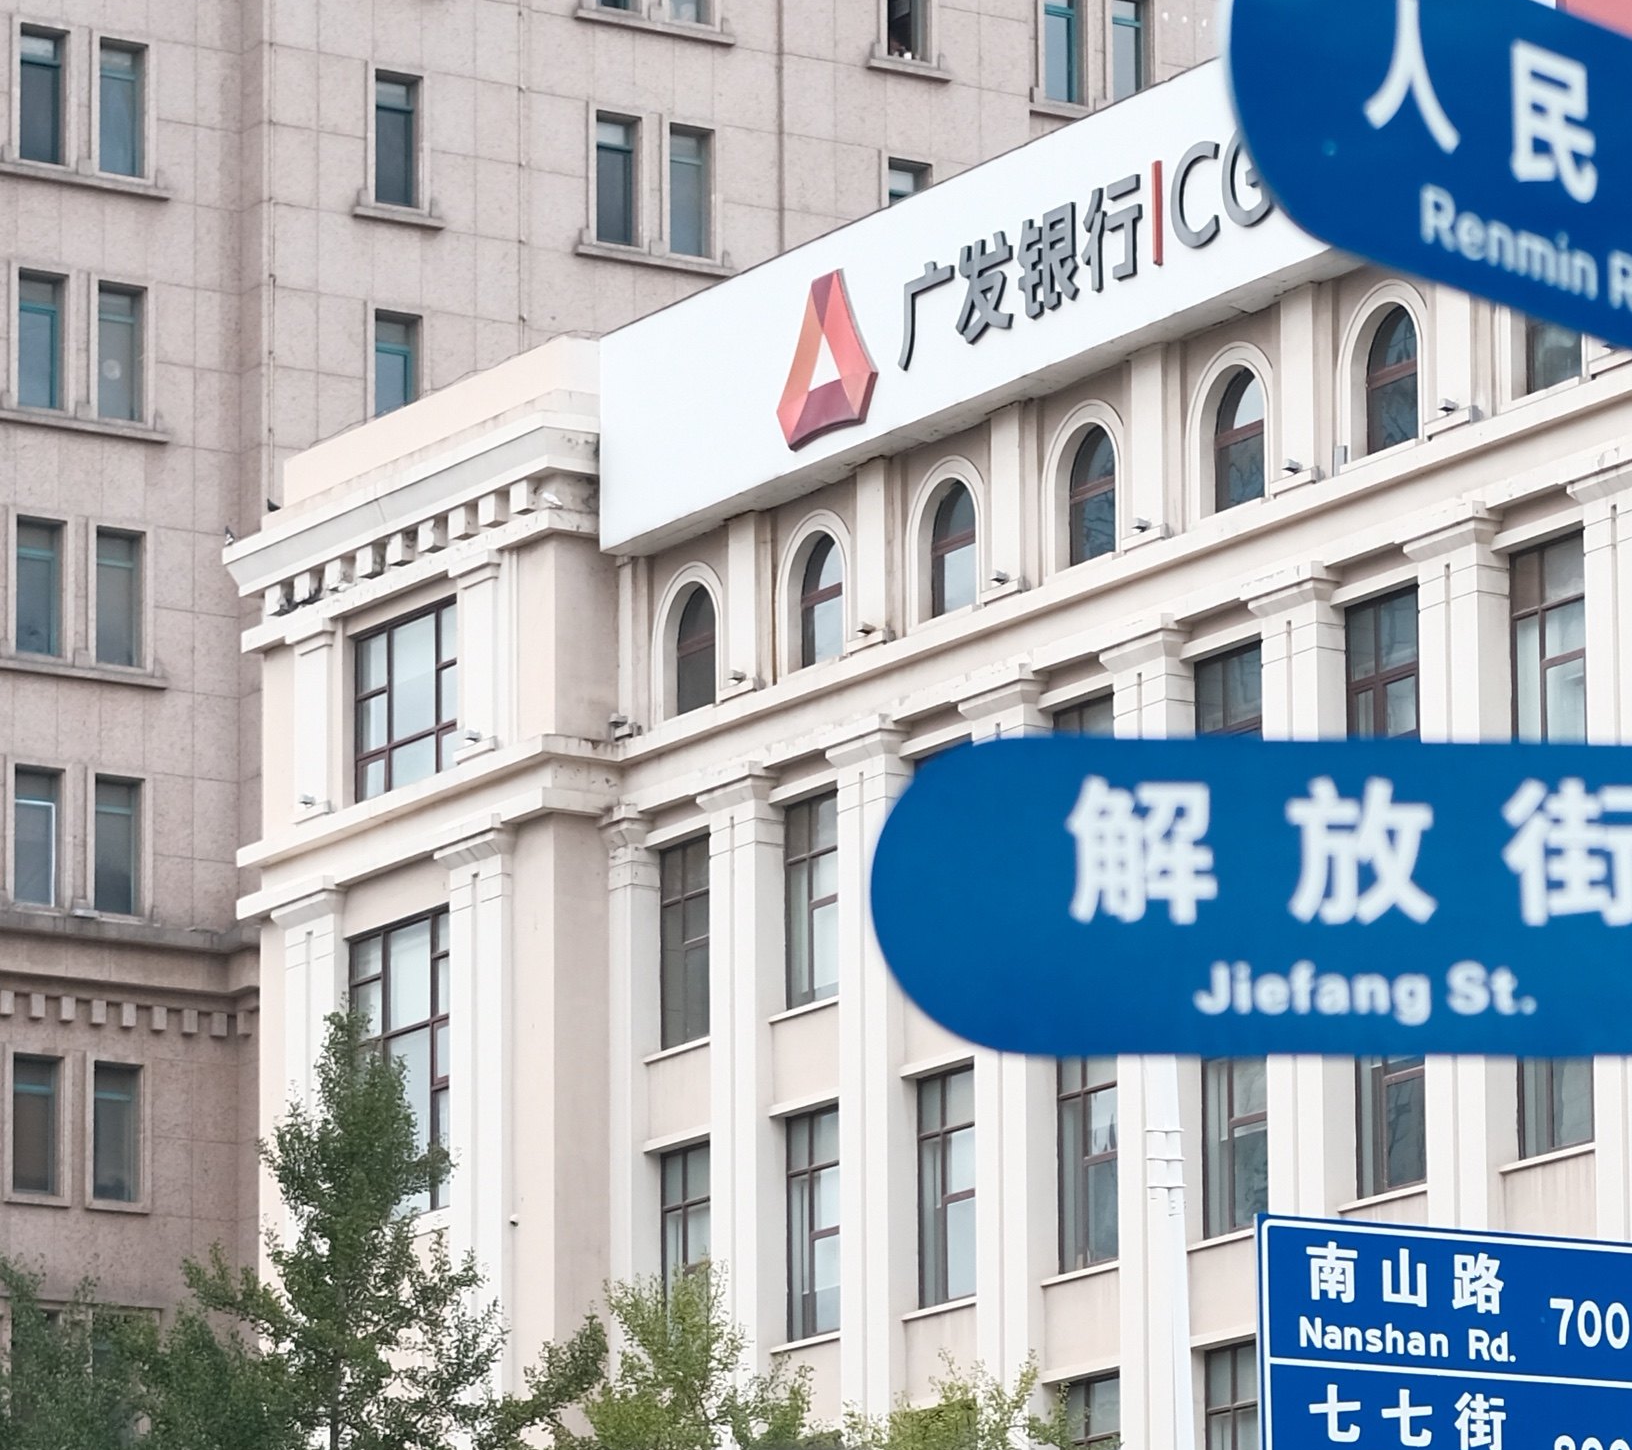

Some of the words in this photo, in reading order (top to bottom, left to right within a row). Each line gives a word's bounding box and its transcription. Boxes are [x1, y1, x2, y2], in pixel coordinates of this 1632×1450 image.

[898, 173, 1144, 372] 广发银行
[1419, 183, 1599, 301] Renmin
[1192, 959, 1432, 1026] Jiefang
[1446, 959, 1537, 1016] St.
[1305, 1240, 1505, 1315] 南山路
[1299, 1315, 1450, 1358] Nanshan
[1467, 1329, 1517, 1363] Rd.
